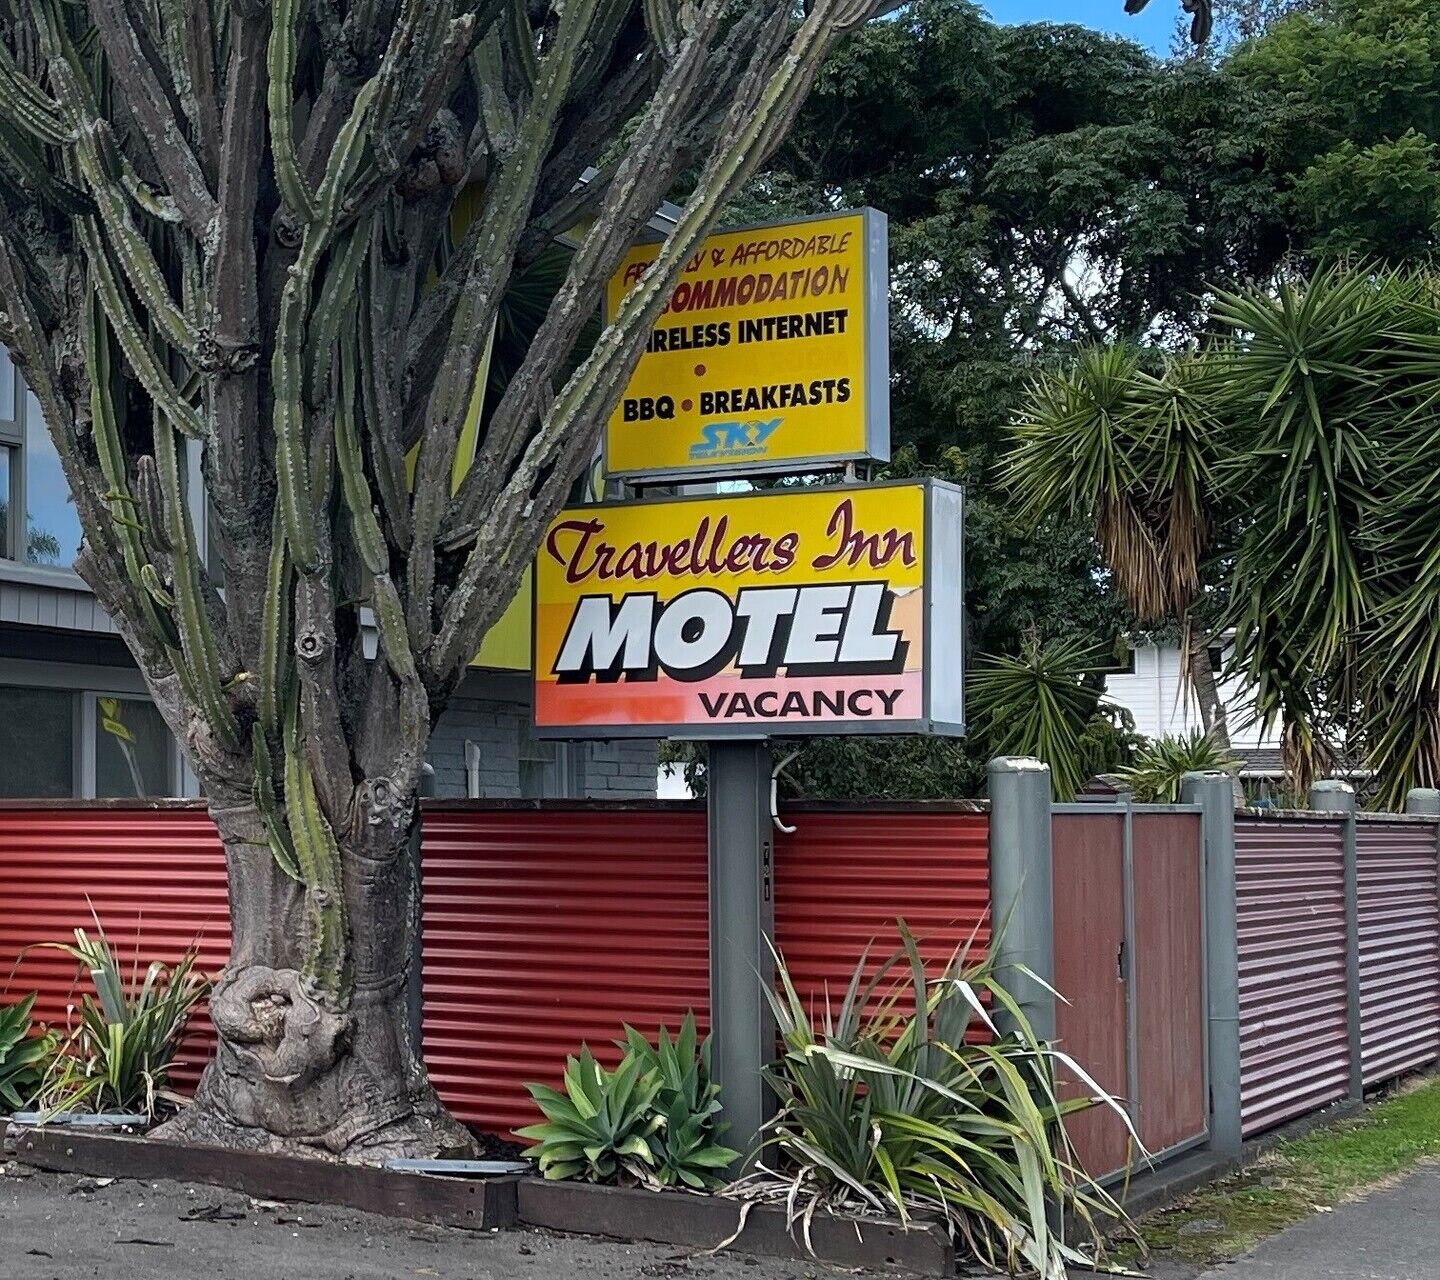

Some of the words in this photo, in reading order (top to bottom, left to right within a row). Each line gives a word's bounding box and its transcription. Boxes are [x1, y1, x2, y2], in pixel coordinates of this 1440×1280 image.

[711, 248, 726, 267] &
[730, 232, 852, 267] AFFORDABLE
[660, 264, 850, 315] OMMODATION
[646, 322, 731, 353] IRELESS
[738, 309, 848, 344] INTERNET
[623, 396, 675, 422] BBQ
[700, 378, 850, 415] BREAKFASTS
[690, 417, 784, 451] SKY
[547, 515, 798, 584] Travellers
[812, 499, 916, 569] Inn
[552, 581, 910, 684] MOTEL
[698, 689, 903, 718] VACANCY
